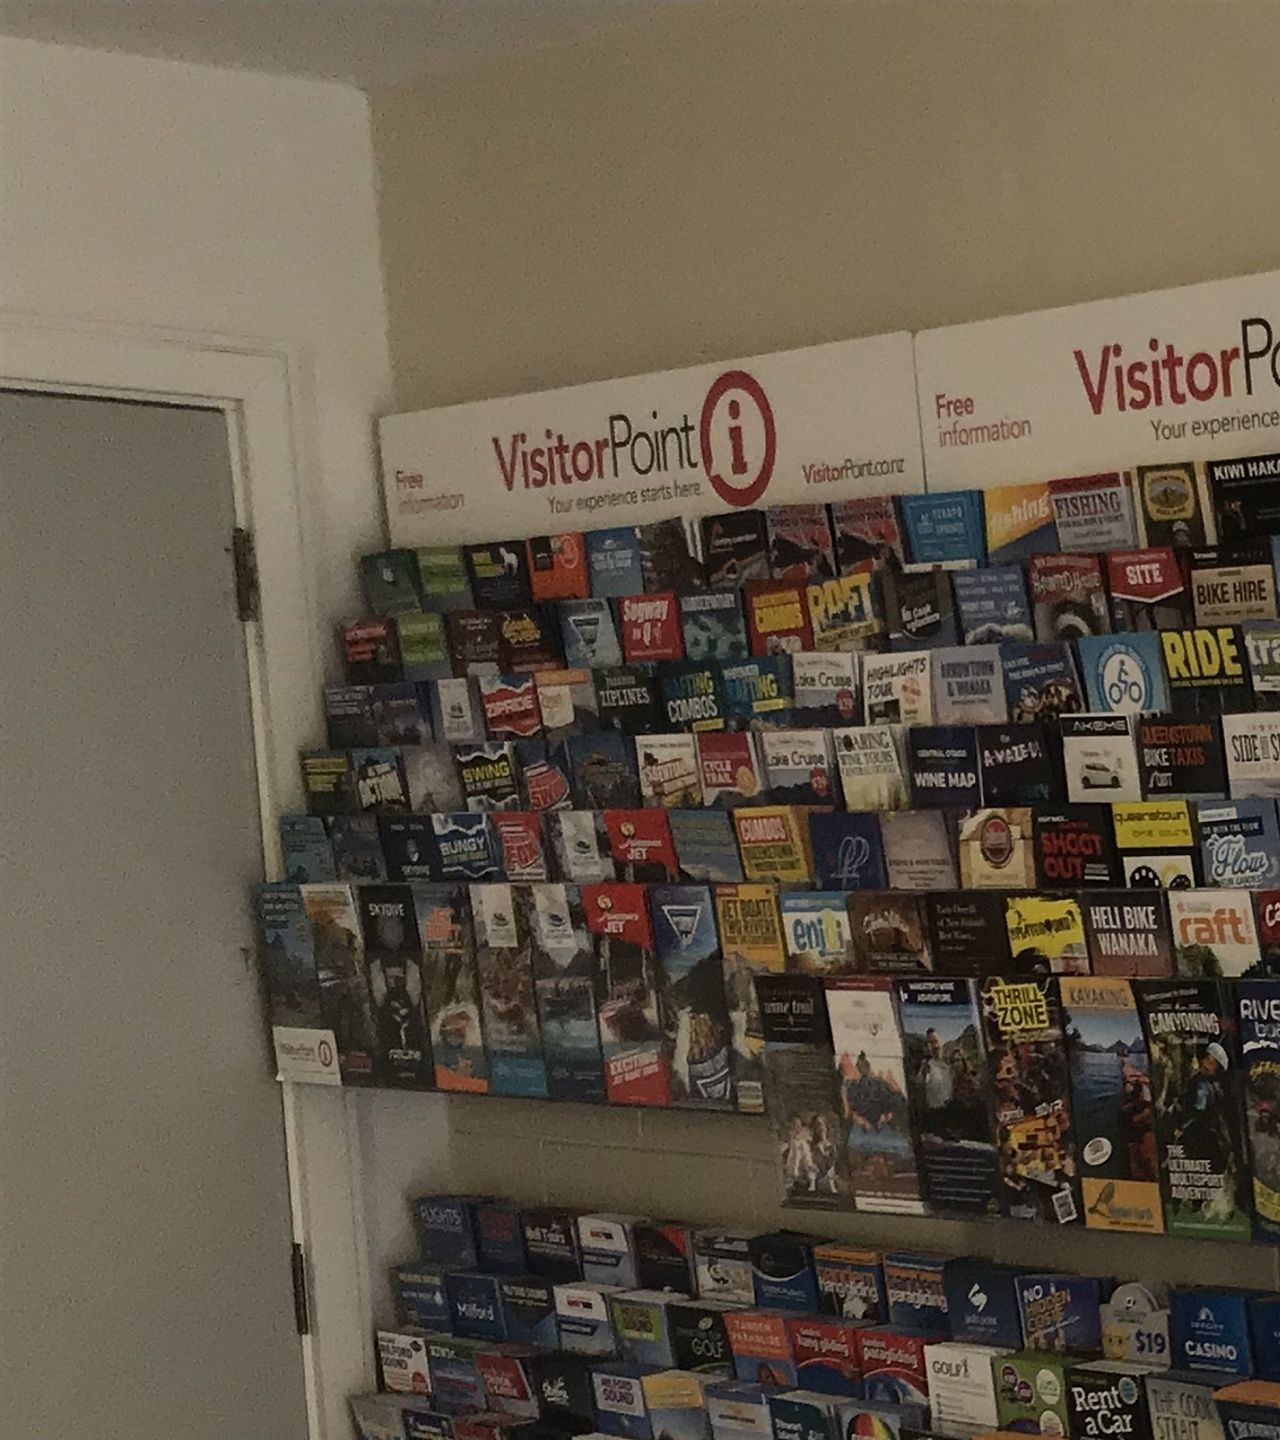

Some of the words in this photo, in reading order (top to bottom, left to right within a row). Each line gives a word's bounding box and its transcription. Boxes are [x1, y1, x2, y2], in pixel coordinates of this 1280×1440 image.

[935, 394, 973, 419] Free
[938, 416, 1031, 447] information
[1150, 419, 1190, 442] Your
[1193, 410, 1279, 441] experience
[493, 412, 698, 491] VisitorPoint
[396, 470, 423, 491] Free
[802, 458, 904, 485] VisitorPoint.co.nz
[1213, 464, 1246, 481] KIWI
[399, 491, 465, 513] information
[548, 493, 582, 515] Your
[584, 487, 637, 513] experience
[640, 483, 672, 504] starts
[674, 479, 704, 498] here.
[1053, 491, 1121, 519] FISHING
[990, 494, 1050, 538] fishing
[1125, 563, 1164, 585] SITE
[1196, 582, 1230, 605] BIKE
[1233, 579, 1267, 602] HIRE
[1161, 627, 1243, 679] RIDE
[819, 668, 852, 687] Cruise
[867, 657, 928, 682] HIGHLIGHTS
[600, 687, 650, 707] ZIPLINES
[868, 681, 895, 698] TOUR
[668, 696, 719, 721] COMBOS
[1141, 724, 1213, 744] QUEENSTOWN
[791, 752, 826, 767] Cruise
[1231, 734, 1261, 763] SIDE
[462, 761, 511, 783] SWING
[705, 772, 734, 784] TRAIL
[913, 772, 946, 790] WINE
[948, 772, 977, 789] MAP
[1115, 809, 1187, 825] queenstown
[738, 817, 786, 841] COMBOS
[438, 836, 487, 857] BUNGY
[626, 847, 649, 861] JET
[1041, 832, 1102, 856] SHOOT
[1045, 856, 1085, 879] OUT
[1213, 835, 1268, 877] Flow
[603, 920, 626, 934] JET
[1090, 906, 1121, 929] HELI
[1122, 905, 1158, 929] BIKE
[1178, 908, 1244, 945] raft
[1097, 932, 1159, 956] WANAKA
[993, 985, 1042, 1005] THRILL
[1068, 986, 1129, 1007] KAYAKING
[998, 1004, 1049, 1030] ZONE
[1149, 1012, 1220, 1036] CANYONING
[1166, 1144, 1184, 1158] THE
[1167, 1159, 1212, 1173] ULTIMATE
[1168, 1173, 1225, 1188] MULTISPORT
[1022, 1285, 1043, 1302] NO
[691, 1339, 724, 1358] GOLF
[1134, 1329, 1166, 1354] $19
[1184, 1340, 1237, 1361] CASINO
[1071, 1387, 1121, 1412] Rent
[1097, 1410, 1134, 1435] Car
